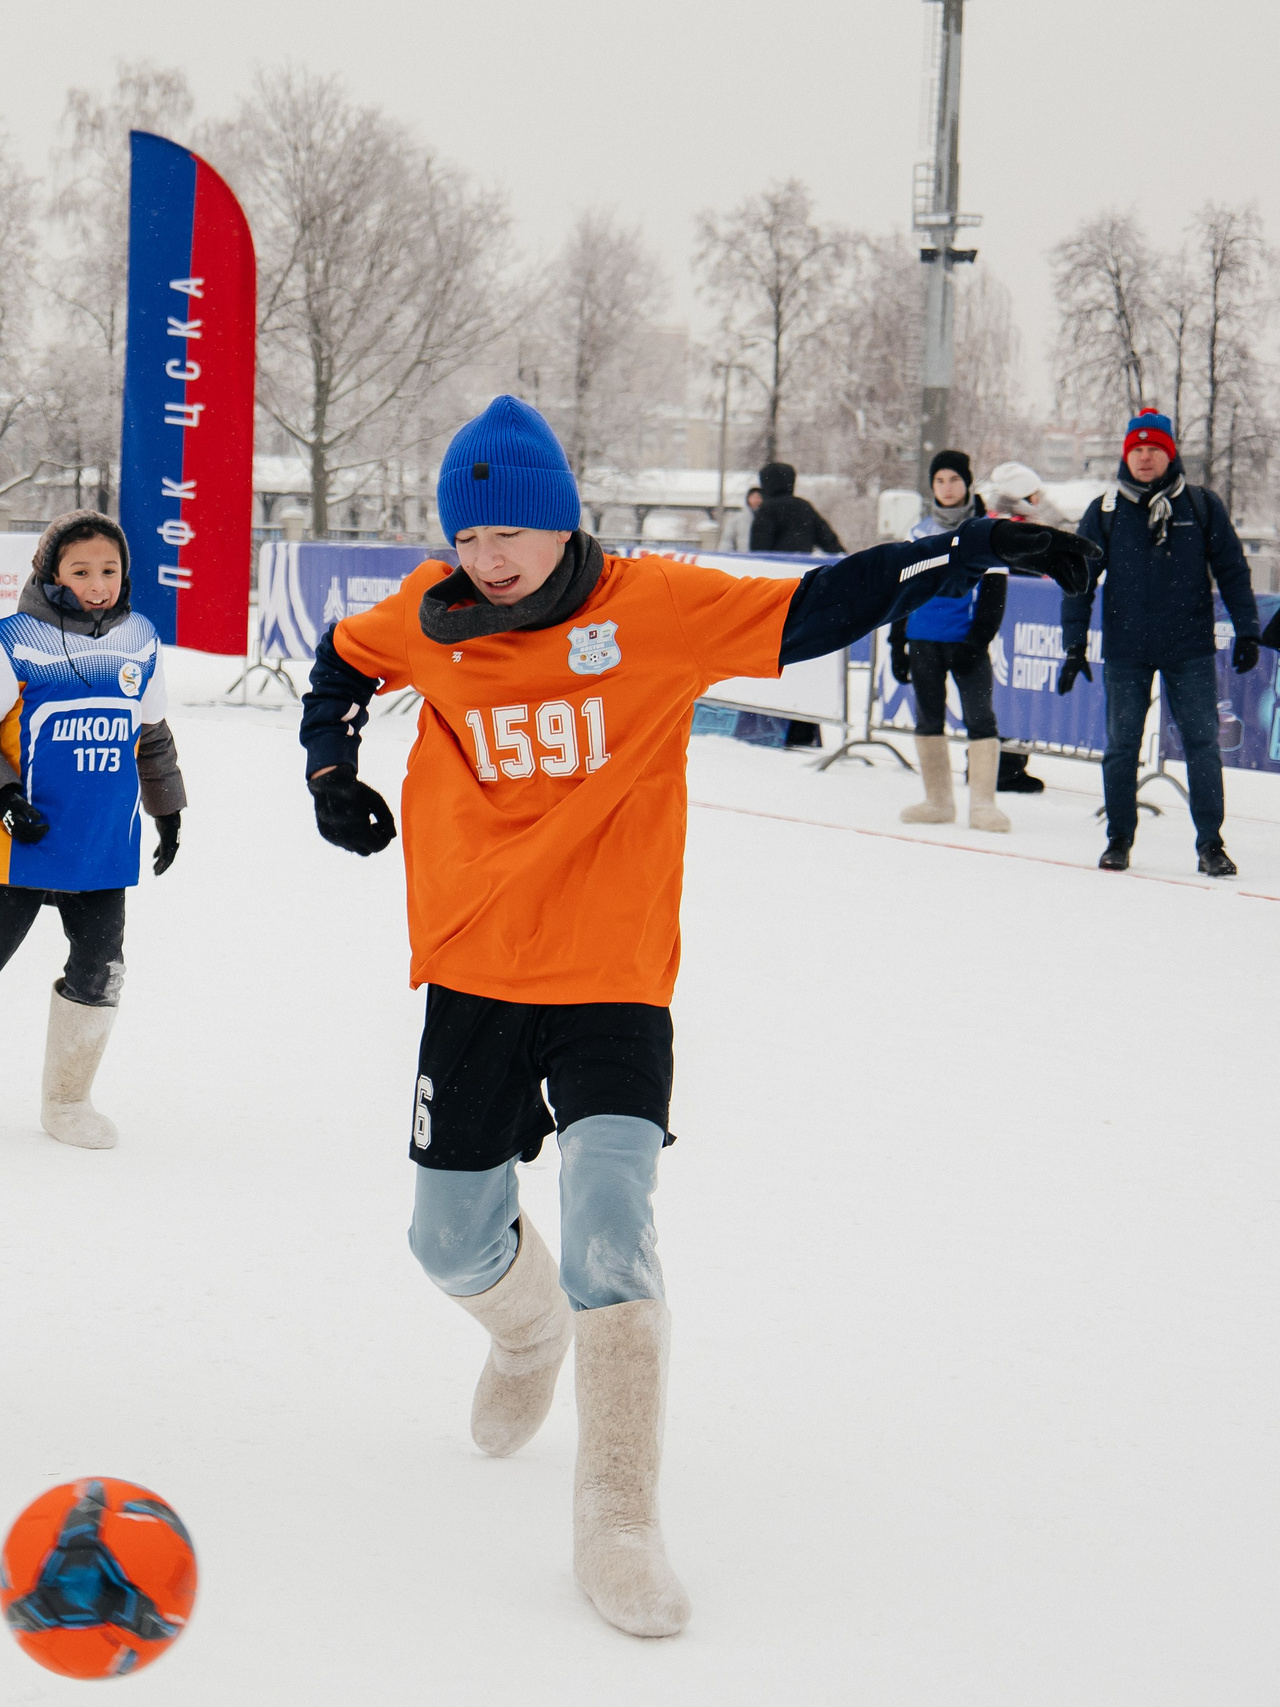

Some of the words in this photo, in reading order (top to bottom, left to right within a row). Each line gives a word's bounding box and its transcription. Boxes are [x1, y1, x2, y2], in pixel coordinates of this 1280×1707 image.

[164, 276, 205, 428] ЦСКА
[157, 477, 198, 589] ПФК
[73, 748, 121, 772] 1173
[465, 697, 611, 781] 1591
[413, 1074, 434, 1150] 6
